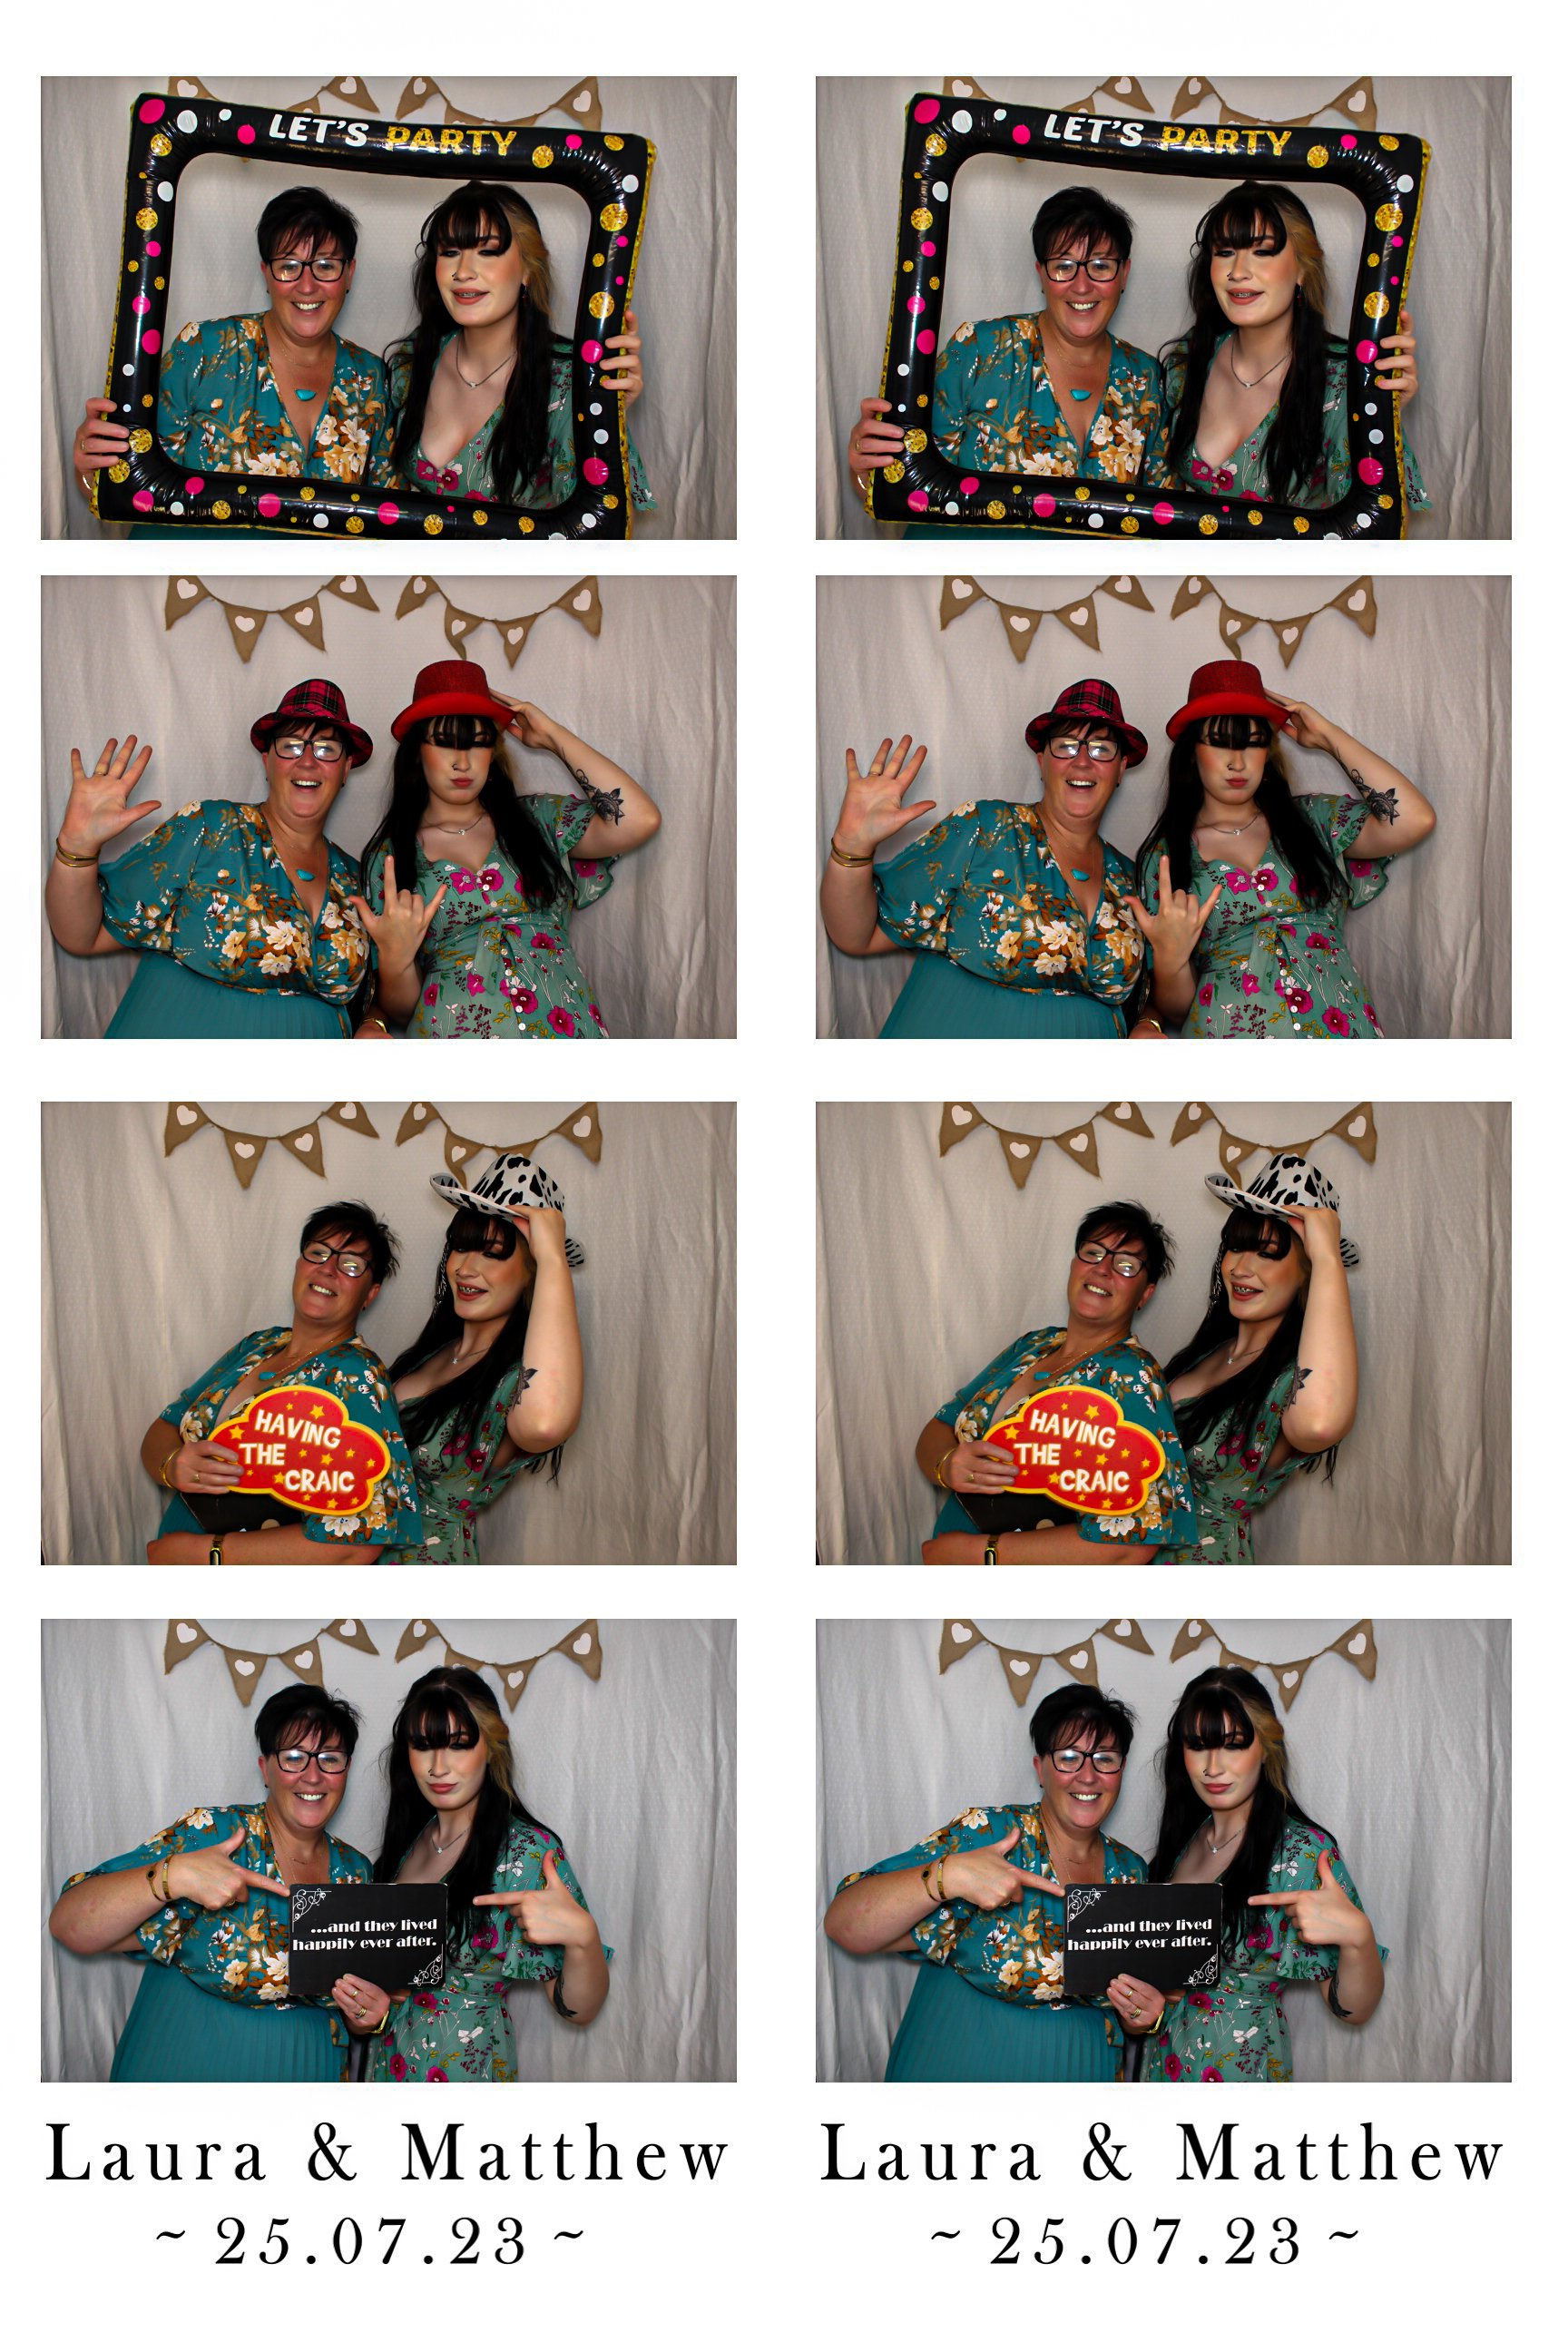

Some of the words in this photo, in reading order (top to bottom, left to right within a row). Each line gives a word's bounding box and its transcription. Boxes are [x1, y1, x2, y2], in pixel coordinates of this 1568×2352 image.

[269, 113, 369, 147] LET'S
[386, 125, 517, 156] PARTY
[1044, 113, 1144, 147] LET'S
[1161, 125, 1292, 156] PARTY
[254, 1408, 342, 1449] HAVING
[1029, 1408, 1117, 1449] HAVING
[239, 1443, 287, 1465] THE
[1014, 1443, 1062, 1465] THE
[284, 1468, 356, 1493] CRAIC
[1059, 1468, 1131, 1493] CRAIC
[364, 1919, 398, 1932] they
[401, 1918, 437, 1931] lived
[1139, 1919, 1173, 1932] they
[1176, 1918, 1212, 1931] lived
[292, 1937, 358, 1951] happily
[359, 1938, 394, 1949] ever
[396, 1936, 437, 1948] after.
[1067, 1937, 1132, 1951] happily
[1134, 1938, 1169, 1949] ever
[1171, 1936, 1212, 1948] after.
